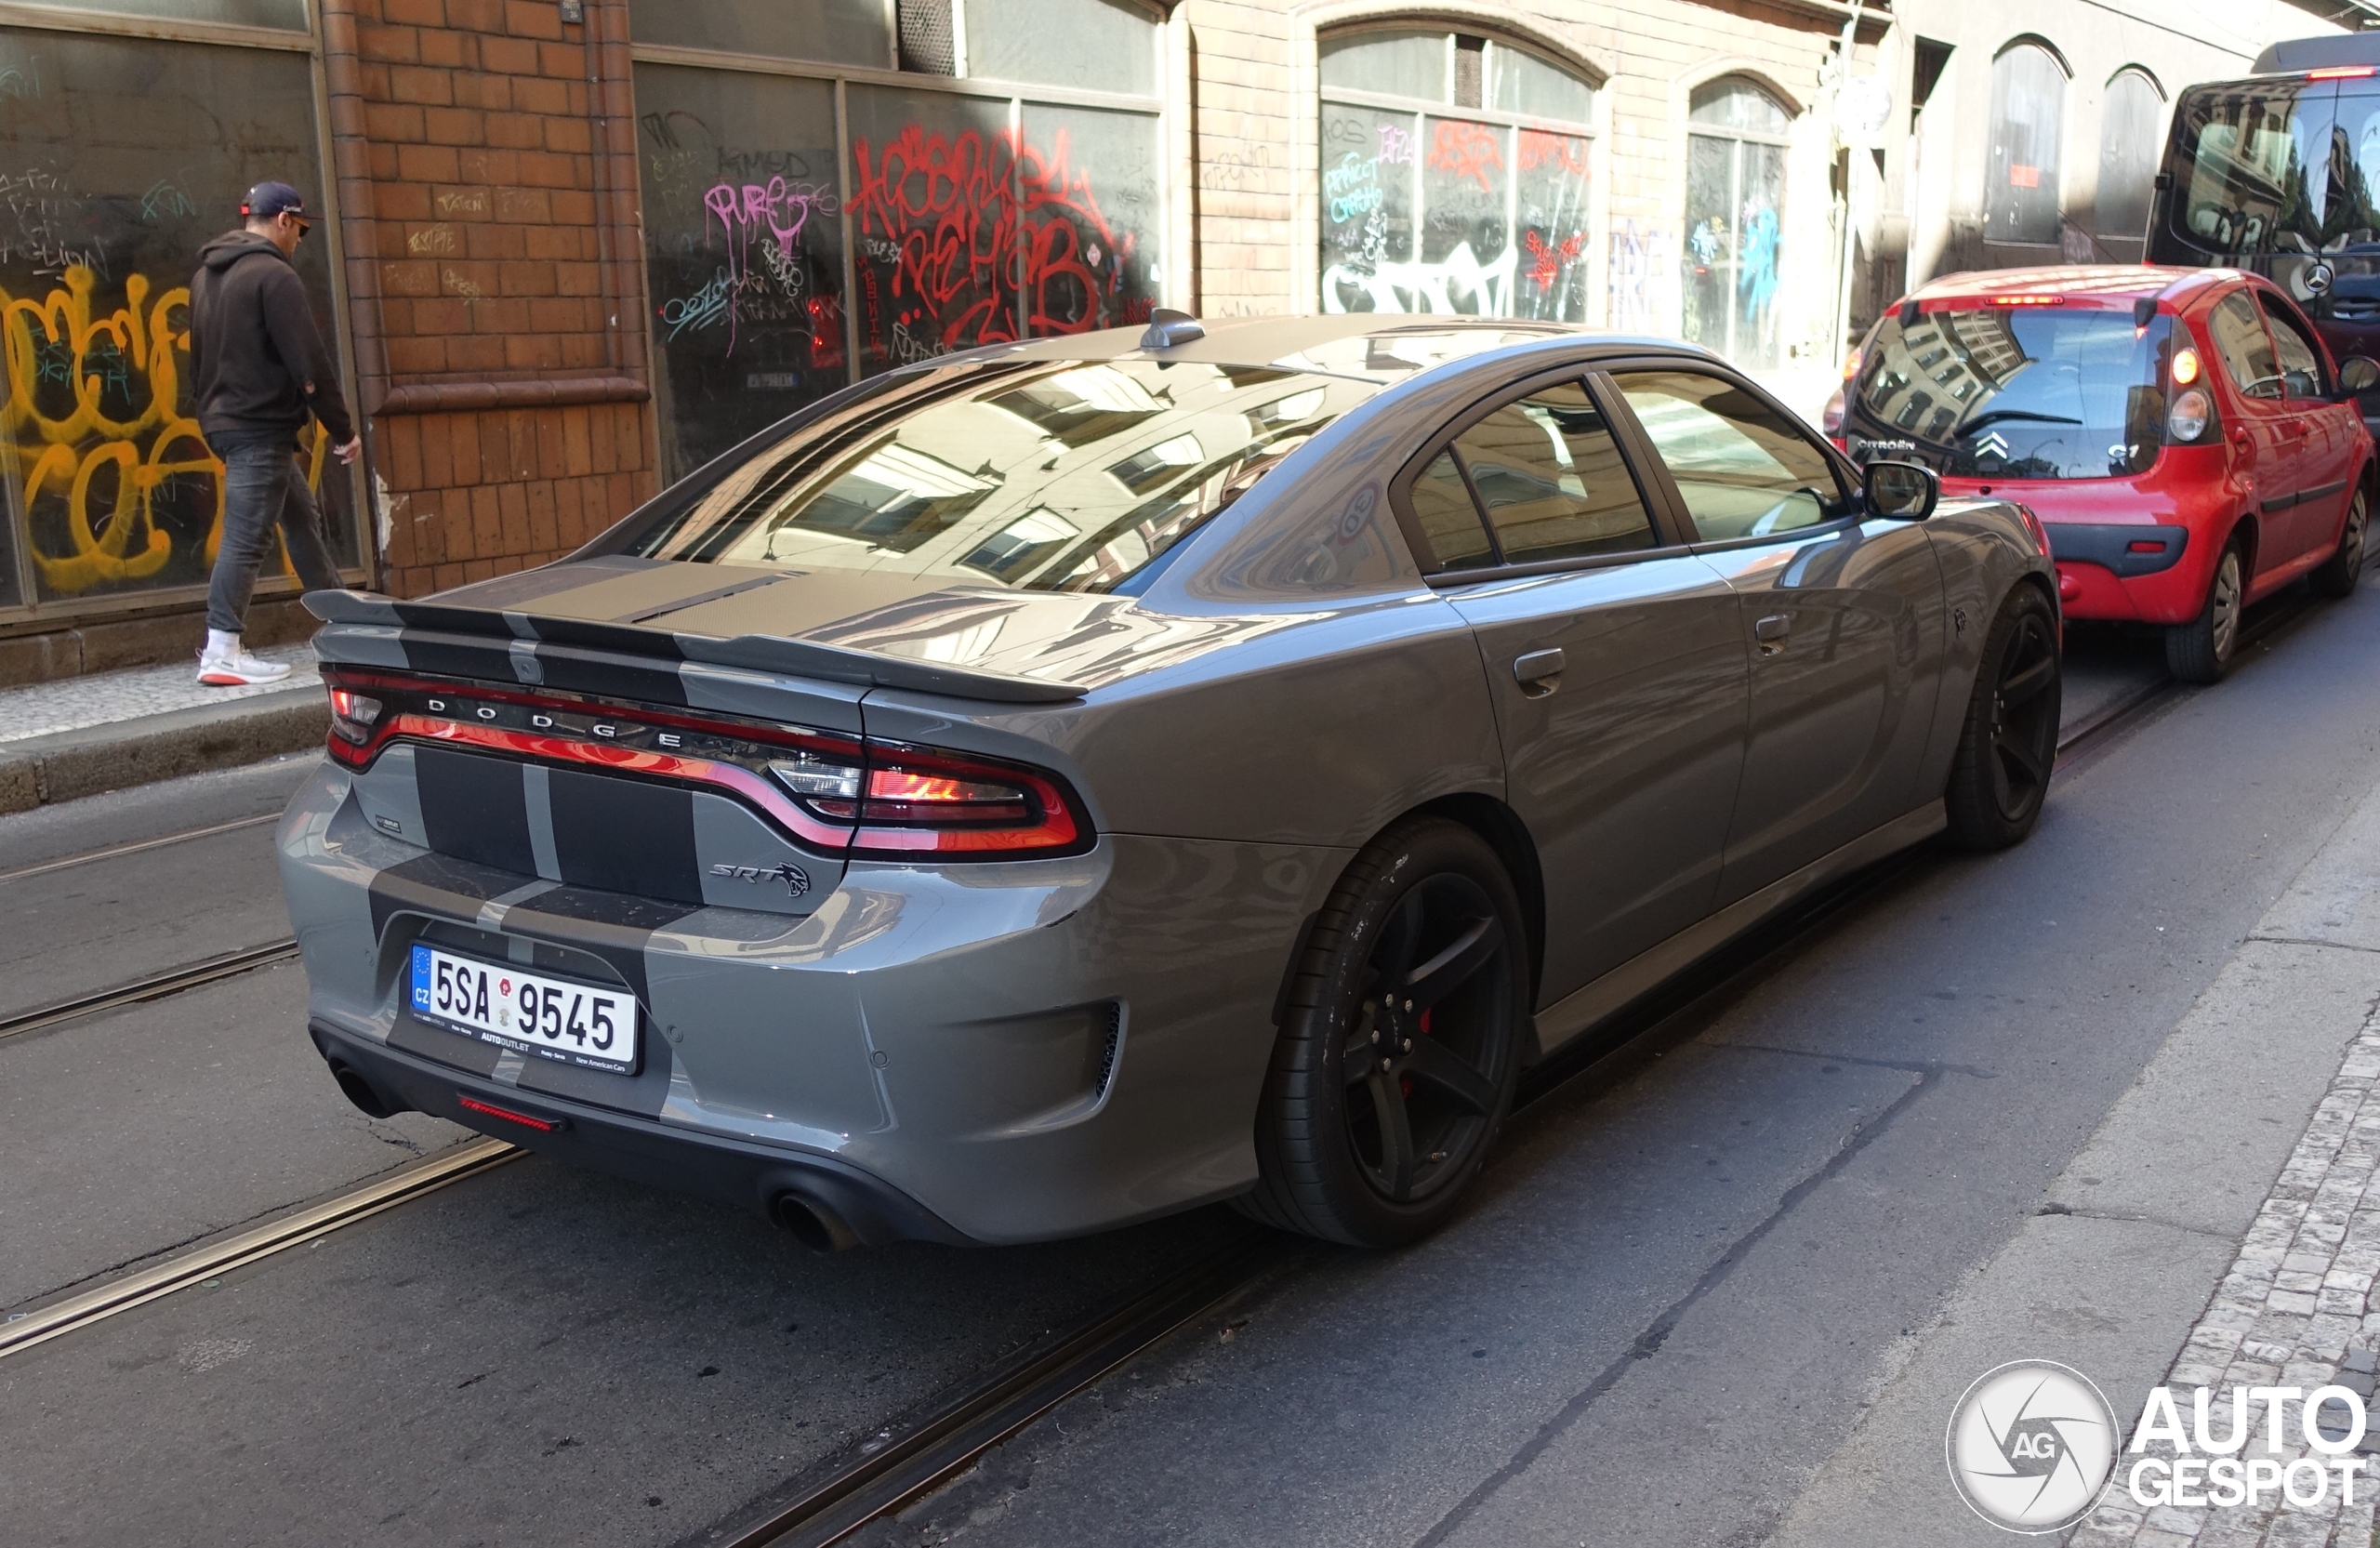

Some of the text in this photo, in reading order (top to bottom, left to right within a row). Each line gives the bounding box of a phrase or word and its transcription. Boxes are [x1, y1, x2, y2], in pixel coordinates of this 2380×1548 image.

[1857, 439, 1916, 451] CITROËN
[2108, 443, 2140, 459] C1
[428, 699, 681, 748] DODGE
[709, 864, 785, 884] SRT
[416, 987, 430, 1004] CZ
[437, 959, 615, 1051] 5SA 9545
[575, 1056, 626, 1073] New American Cars
